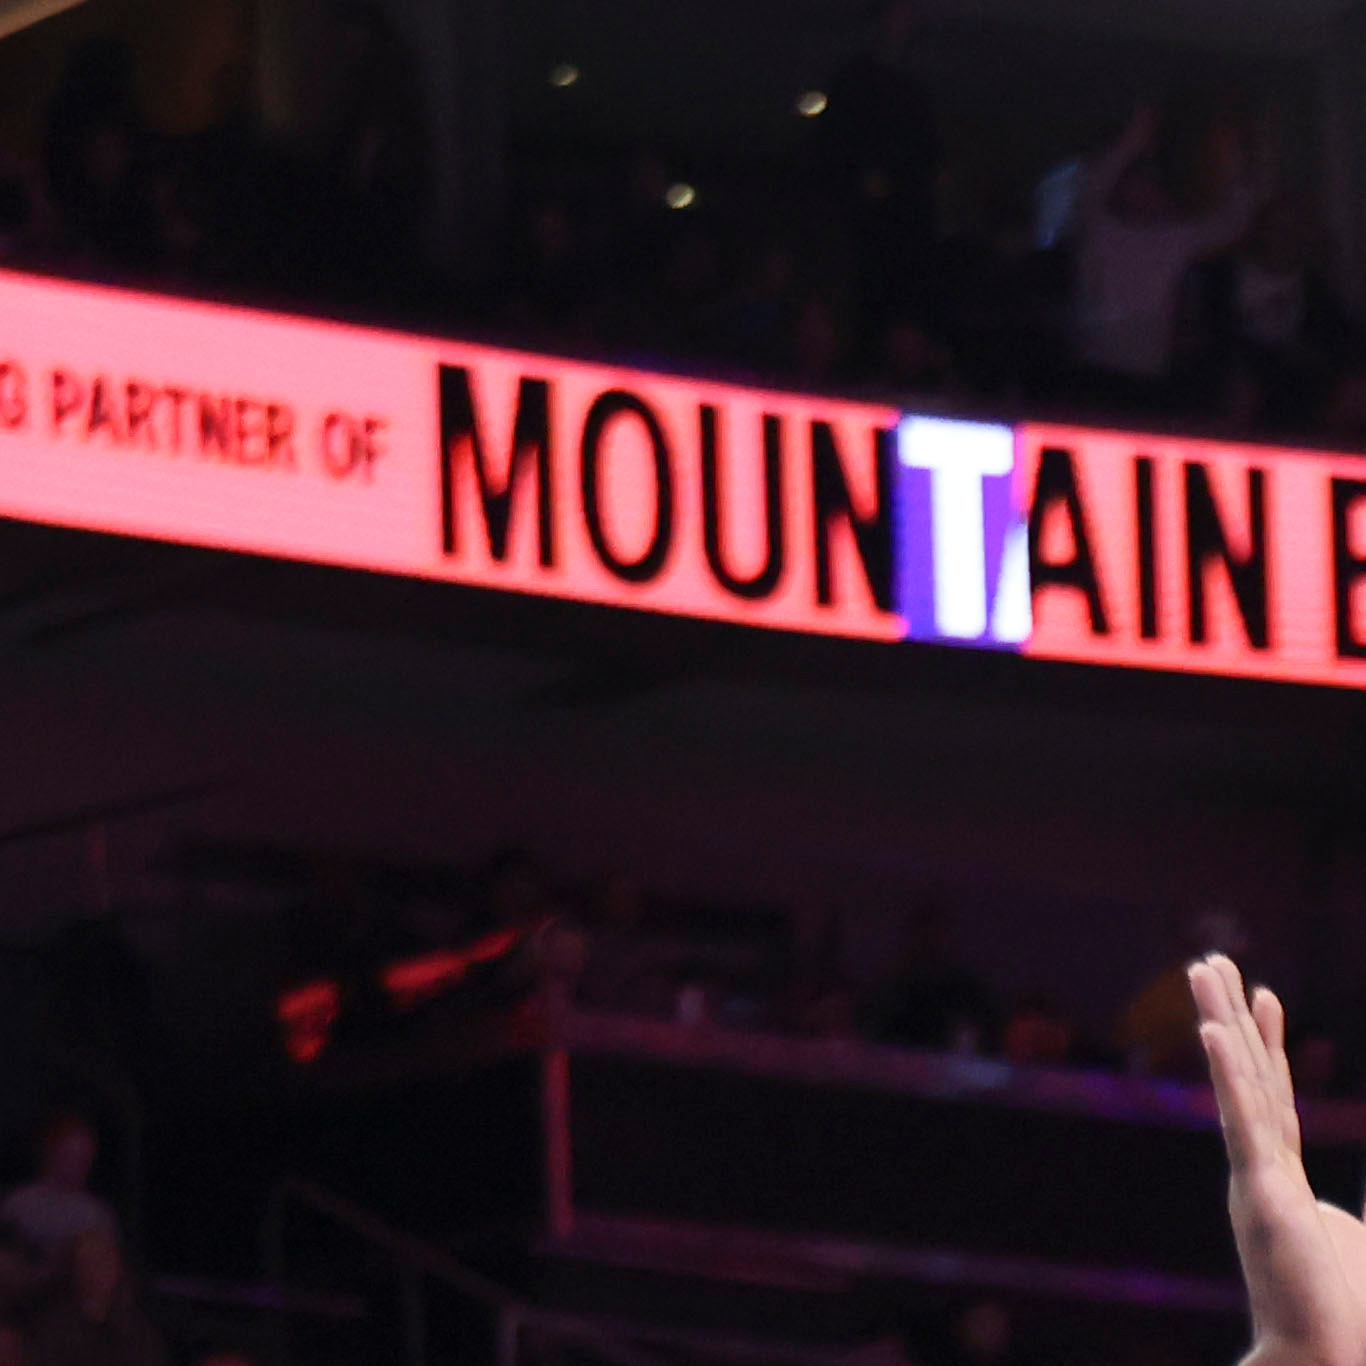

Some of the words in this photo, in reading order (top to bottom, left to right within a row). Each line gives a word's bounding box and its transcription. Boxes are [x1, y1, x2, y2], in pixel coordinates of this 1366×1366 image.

[53, 370, 297, 470] PARTNER
[323, 412, 390, 484] OF
[438, 363, 1269, 650] MOUNTAIN
